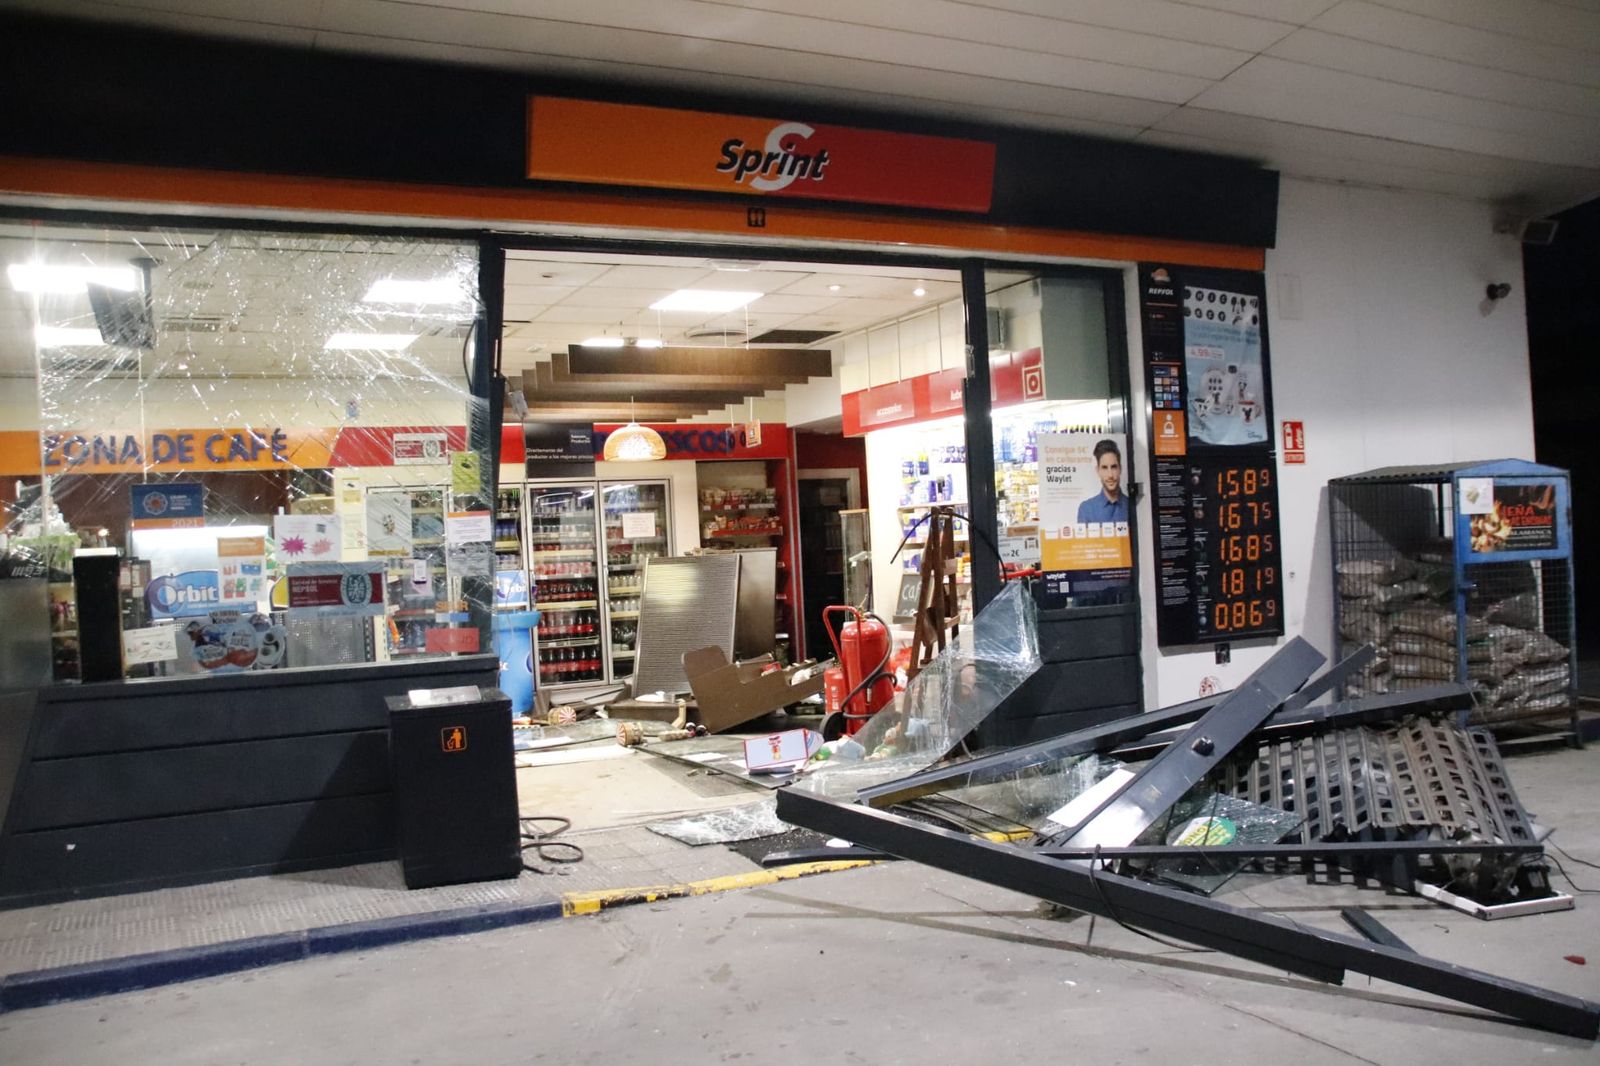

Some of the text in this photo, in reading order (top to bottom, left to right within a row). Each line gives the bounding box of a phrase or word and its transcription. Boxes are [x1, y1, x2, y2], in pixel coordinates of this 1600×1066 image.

[716, 139, 829, 183] Sprint
[44, 428, 289, 466] ZONA DE CAFÉ
[1046, 466, 1071, 475] gracias
[1046, 475, 1072, 484] Waylet
[1046, 572, 1067, 580] waylet
[147, 579, 218, 610] Orbit
